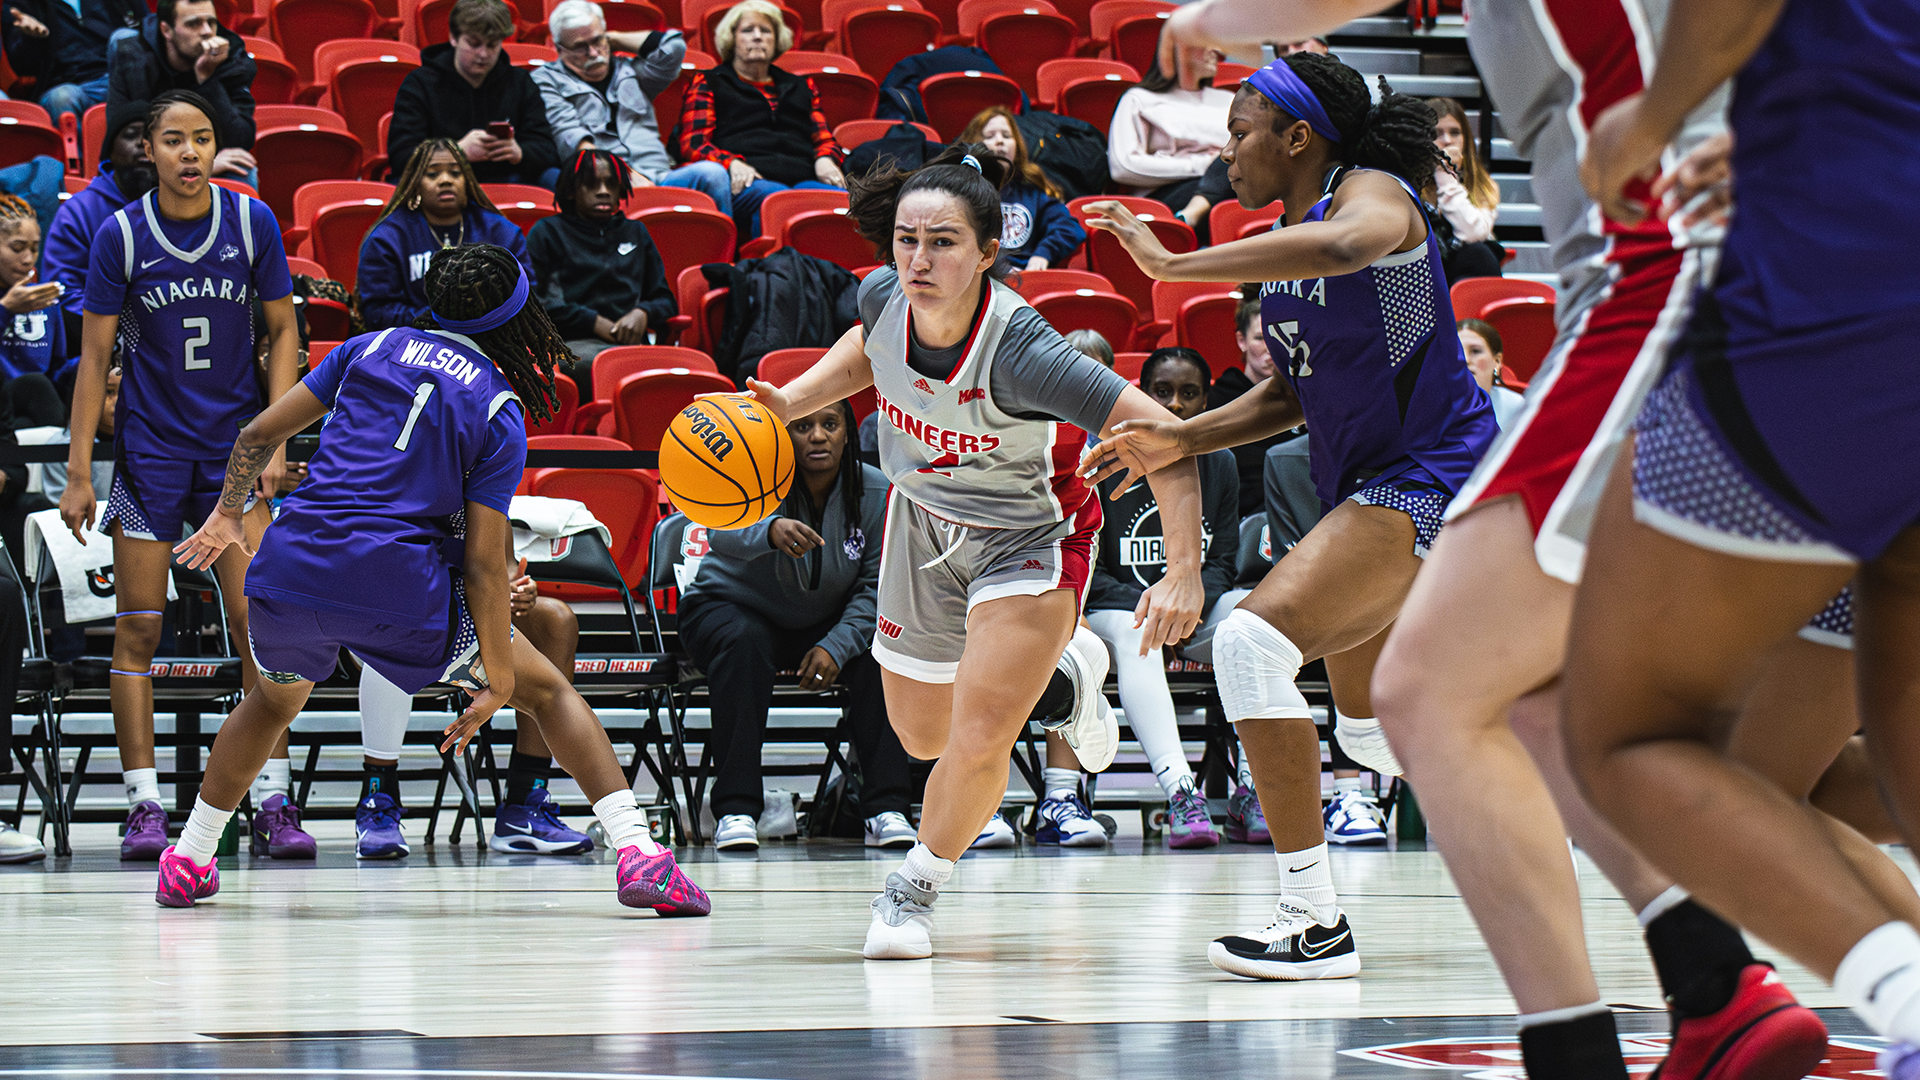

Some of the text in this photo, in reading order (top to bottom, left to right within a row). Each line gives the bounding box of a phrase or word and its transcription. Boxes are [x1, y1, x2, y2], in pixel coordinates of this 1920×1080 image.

[140, 277, 247, 313] NIAGARA
[182, 316, 211, 371] 2
[399, 338, 482, 386] WILSON
[393, 381, 436, 452] 1
[877, 613, 905, 640] SHU
[171, 664, 223, 677] HEART
[575, 659, 657, 673] CRED HEART
